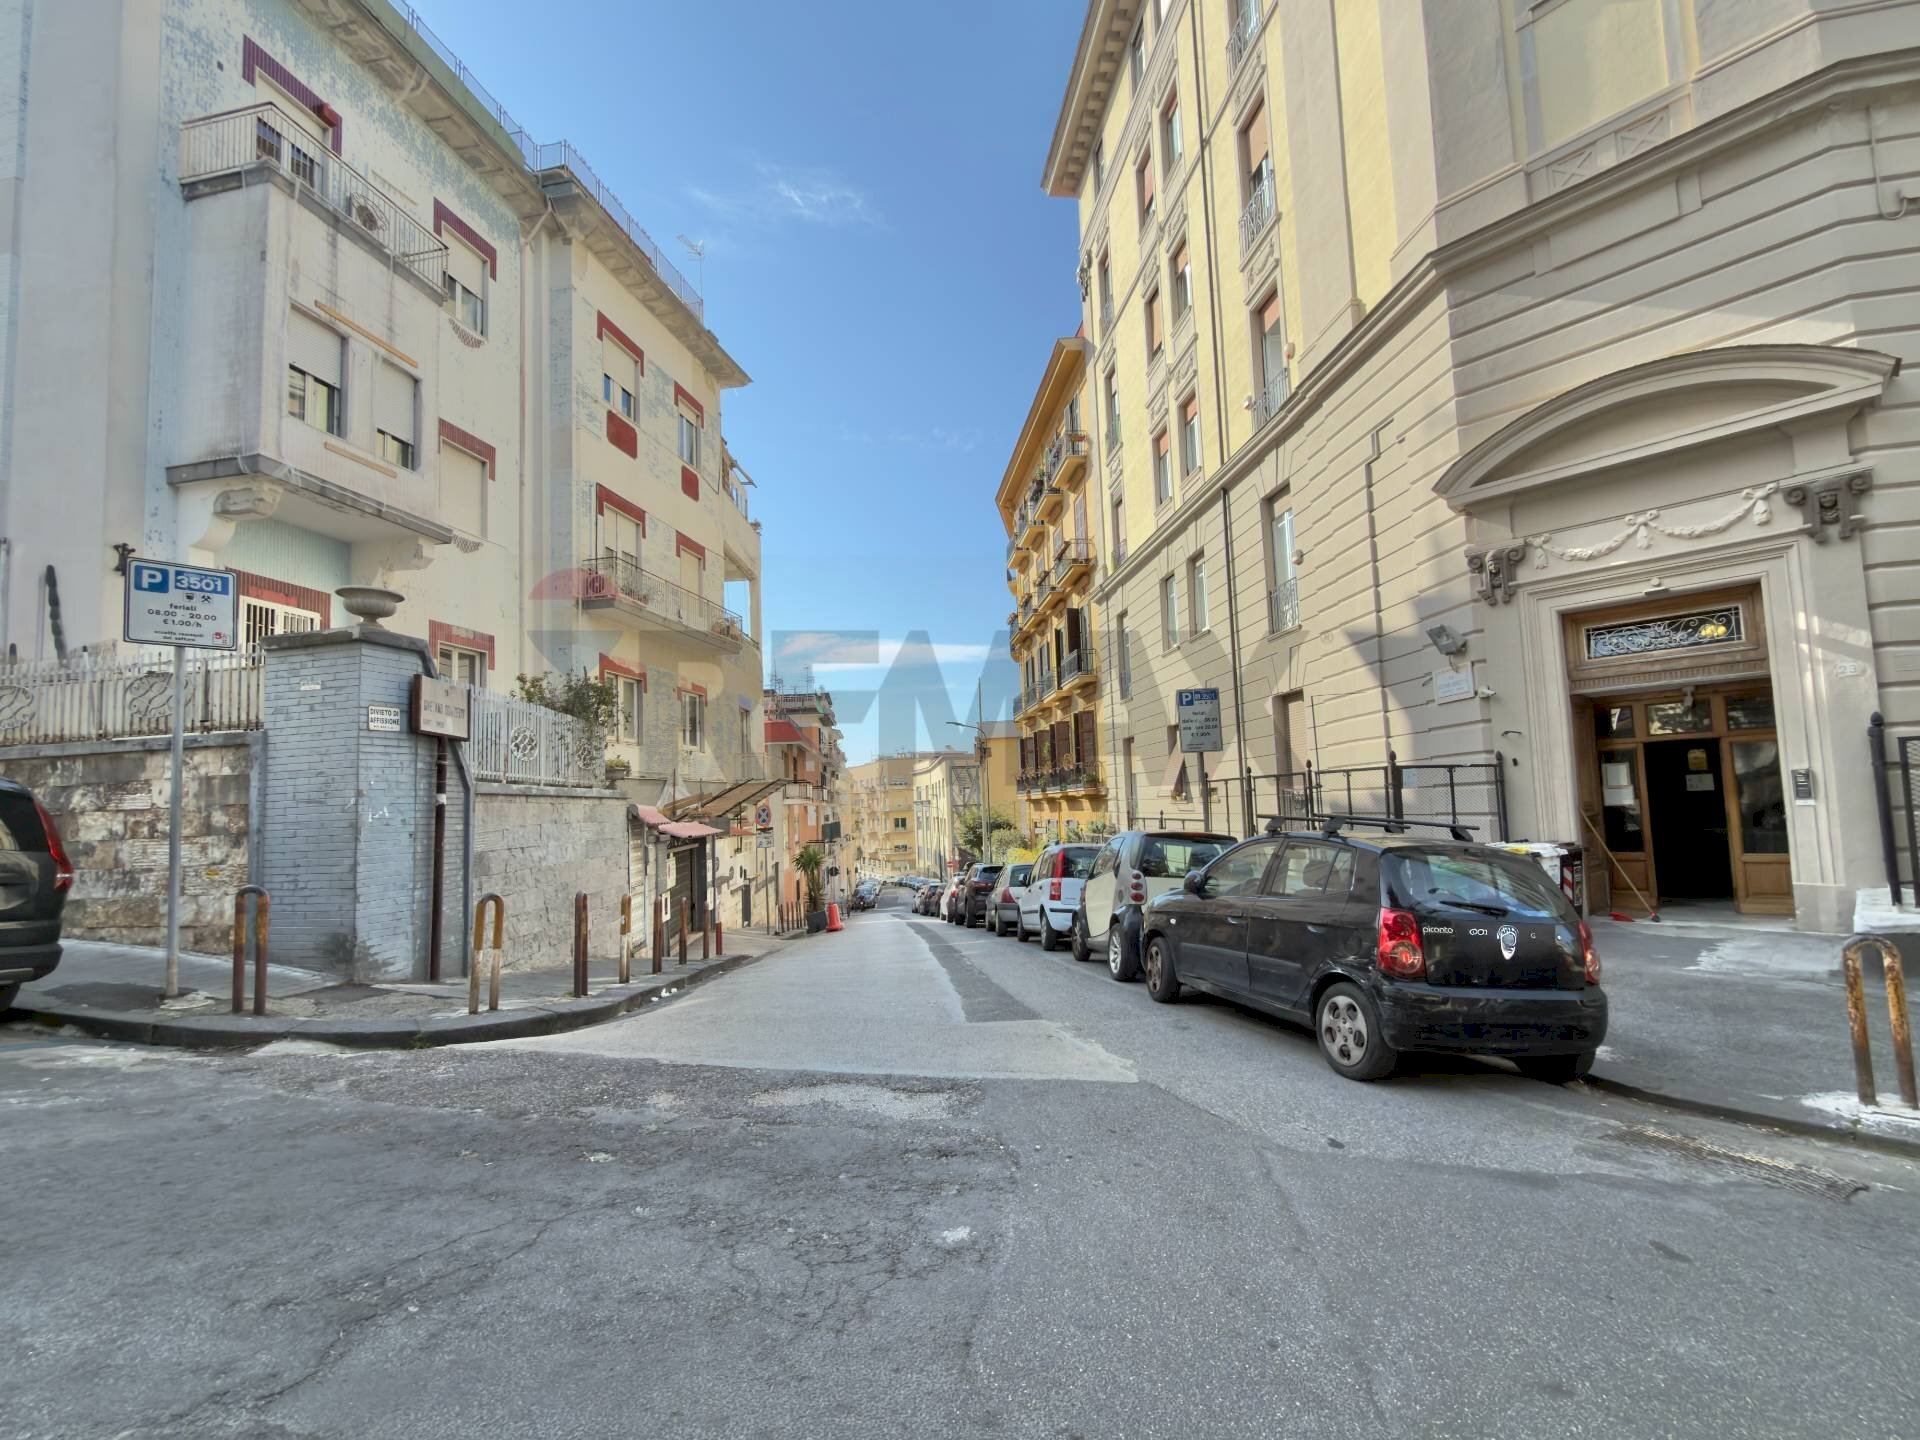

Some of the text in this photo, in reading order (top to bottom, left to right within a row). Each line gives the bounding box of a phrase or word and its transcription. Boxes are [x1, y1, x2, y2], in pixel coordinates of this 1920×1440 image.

[142, 569, 162, 589] P
[176, 575, 222, 592] 3501
[169, 603, 197, 611] feriali
[1182, 692, 1191, 705] P
[370, 708, 392, 716] DIVIETO
[370, 717, 400, 725] AFFISSIONE
